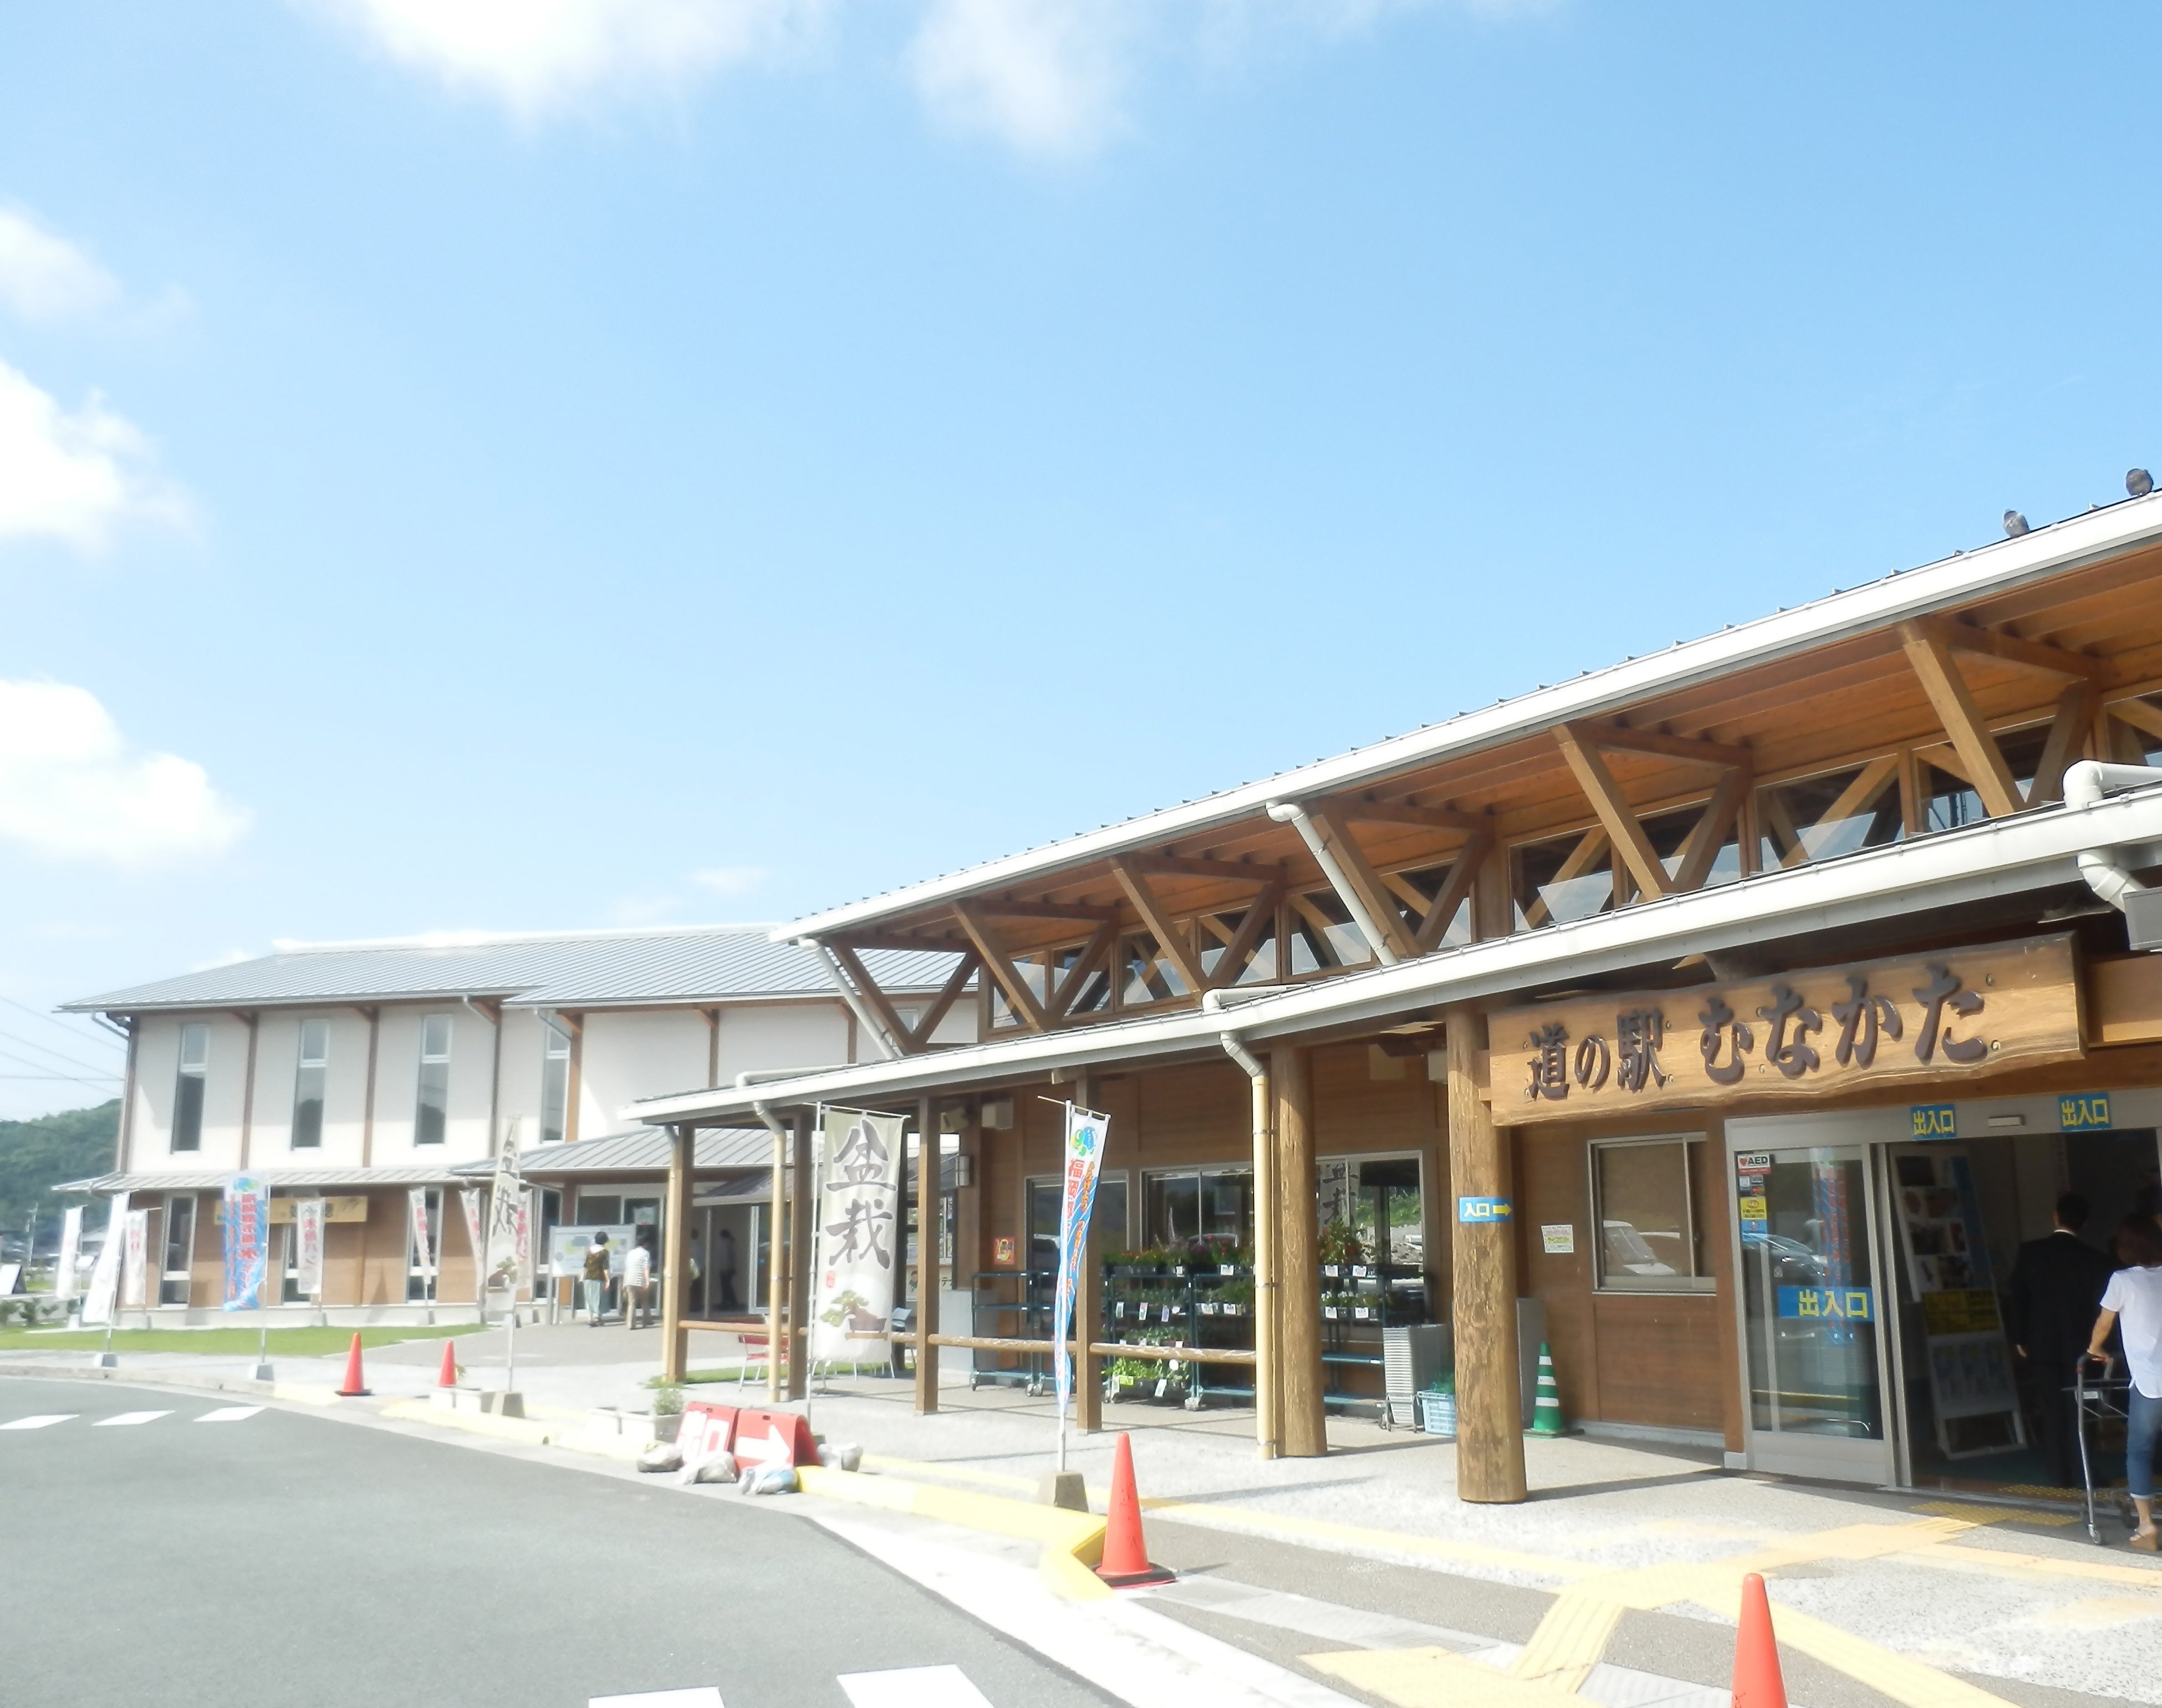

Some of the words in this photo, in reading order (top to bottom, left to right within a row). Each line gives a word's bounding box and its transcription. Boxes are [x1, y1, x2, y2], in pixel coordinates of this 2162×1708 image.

[1528, 1007, 1666, 1100] 道の駅
[1698, 962, 1988, 1086] むなかた
[1913, 1110, 1955, 1135] 出入口
[2061, 1099, 2109, 1126] 出入口
[1747, 1156, 1768, 1165] AED
[825, 1119, 897, 1269] 盆栽
[1464, 1202, 1490, 1217] 入口
[1798, 1289, 1869, 1318] 出入口
